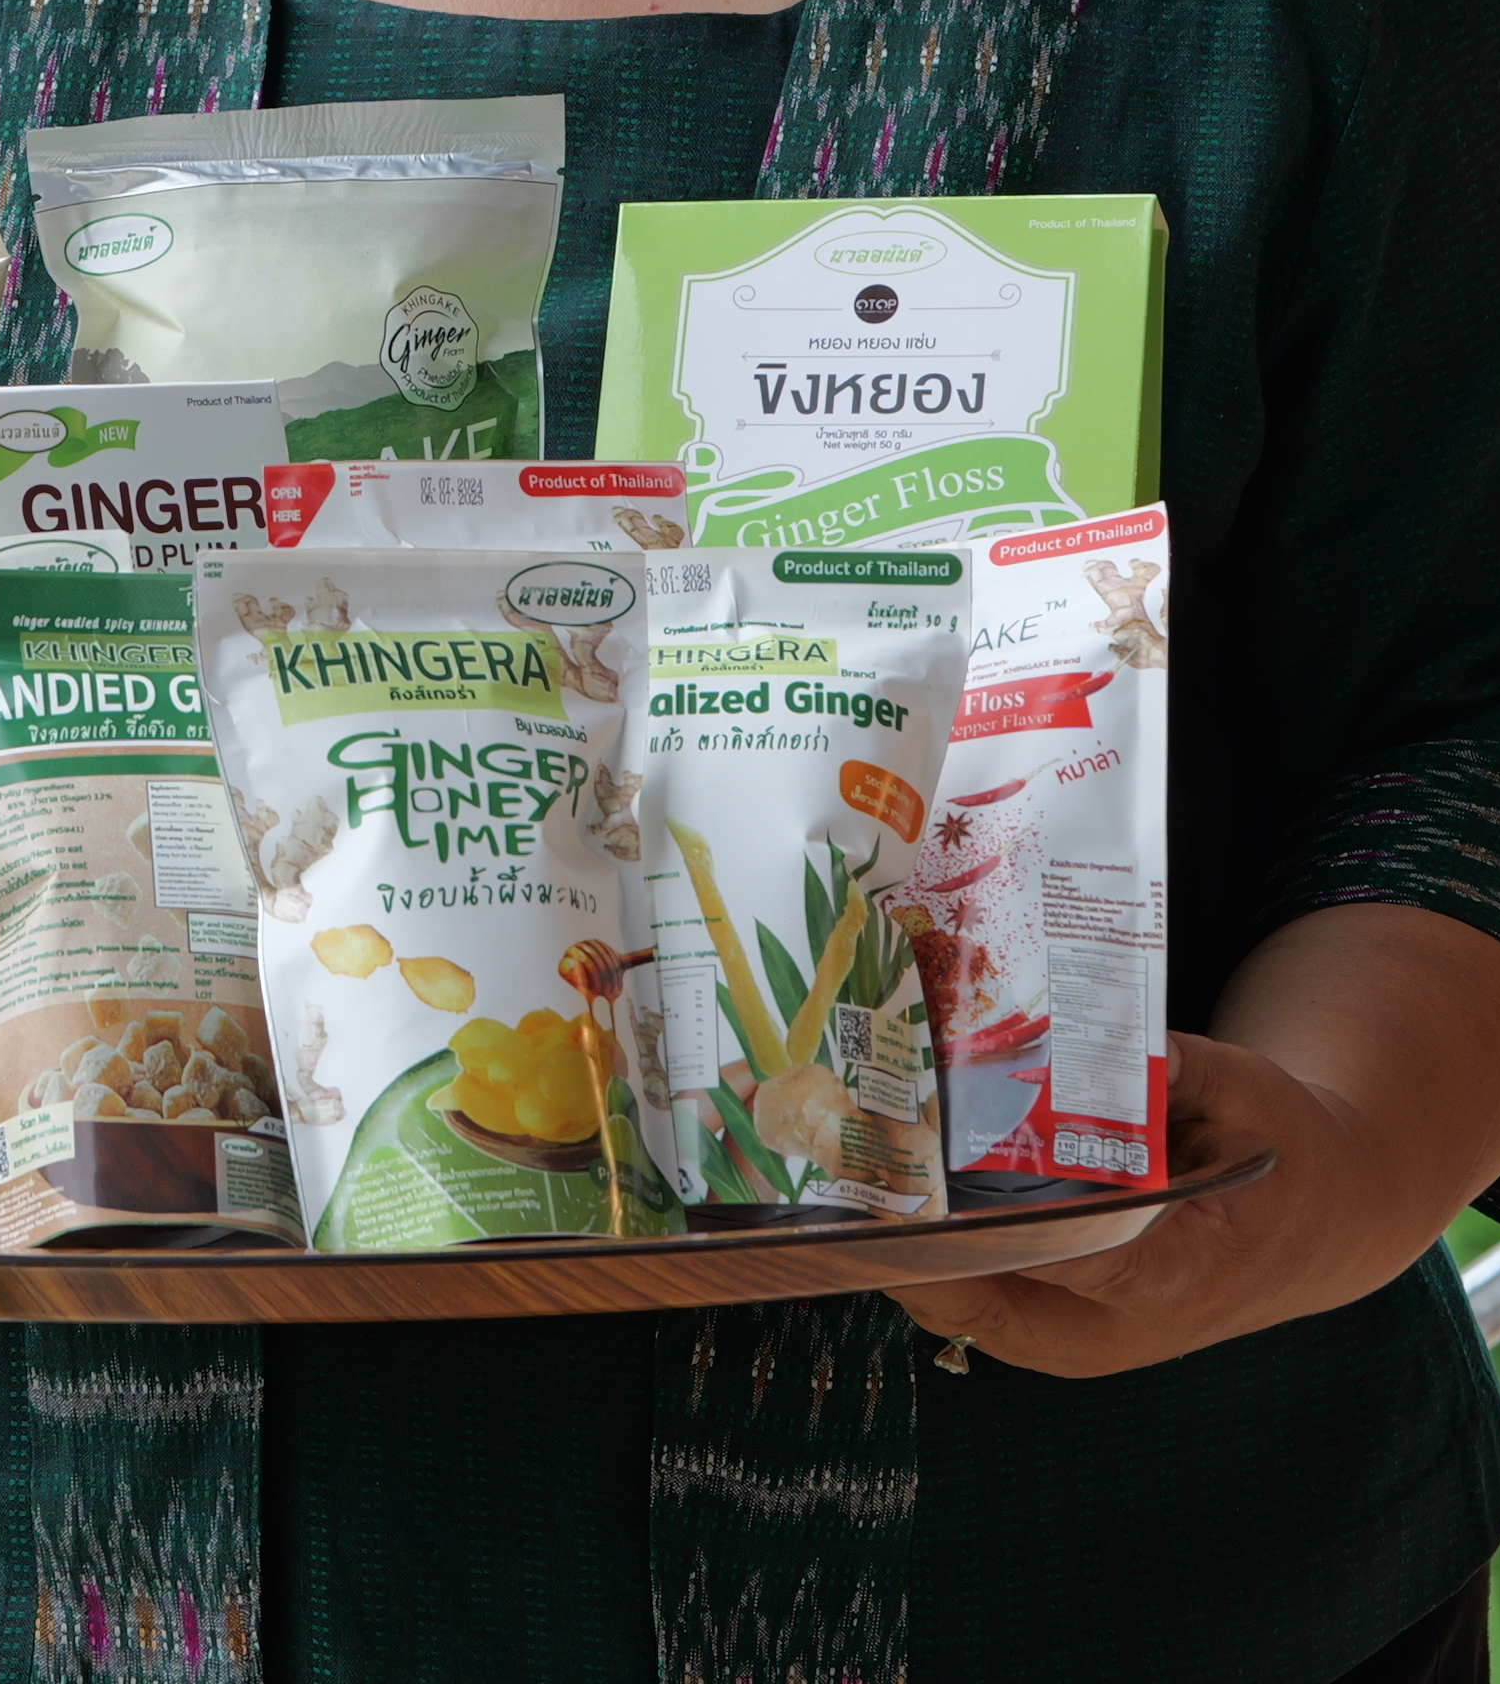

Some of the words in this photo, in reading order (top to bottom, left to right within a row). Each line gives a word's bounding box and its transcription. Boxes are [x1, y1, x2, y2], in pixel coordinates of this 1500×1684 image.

[1029, 219, 1070, 229] Product
[1075, 219, 1086, 228] of
[1091, 217, 1137, 228] Thailand
[401, 294, 461, 318] KHINGAKE
[388, 323, 471, 374] Ginger
[808, 337, 852, 350] หยอง
[857, 337, 900, 350] หยอง
[905, 332, 937, 350] แซ่บ
[443, 347, 465, 357] From
[402, 373, 439, 404] Product
[754, 363, 986, 415] ขิงหยอง
[186, 396, 222, 407] Product
[223, 396, 233, 406] of
[234, 395, 273, 405] Thailand
[98, 425, 130, 444] NEW
[874, 430, 887, 438] 50
[823, 440, 842, 449] Net
[843, 440, 877, 451] weight
[880, 440, 893, 449] 50
[528, 474, 586, 489] Product
[589, 474, 606, 488] of
[608, 474, 673, 489] Thailand
[271, 487, 302, 500] OPEN
[21, 476, 267, 534] GINGER
[736, 493, 881, 547] Ginger
[891, 466, 1005, 511] Floss
[272, 510, 302, 523] HERE
[587, 541, 611, 552] TM
[1000, 538, 1062, 559] Product
[1066, 532, 1083, 547] of
[1086, 518, 1154, 543] Thailand
[784, 559, 854, 577] Product
[855, 561, 875, 576] of
[877, 561, 950, 578] Thailand
[518, 577, 619, 609] นวลอนันต์
[1045, 598, 1067, 612] TM
[12, 614, 50, 631] Ginger
[55, 616, 100, 629] Candied
[104, 618, 135, 633] Spicy
[925, 614, 942, 628] 30
[949, 615, 958, 633] g
[272, 640, 552, 695] KHINGERA
[1053, 656, 1081, 666] Brand
[840, 669, 876, 679] Brand
[389, 685, 477, 701] คิงส์เกอร่า
[784, 681, 909, 732] Ginger
[964, 690, 1026, 716] Floss
[515, 718, 532, 735] By
[951, 720, 998, 739] epper
[1002, 712, 1056, 728] Flavor
[327, 728, 589, 818] GINGER
[8, 801, 26, 811] 85%
[60, 793, 91, 802] (Sugar)
[346, 777, 561, 829] HONEY
[55, 846, 65, 854] to
[59, 862, 69, 870] to
[72, 862, 87, 870] eat
[122, 945, 139, 953] keep
[128, 981, 150, 989] pouch
[196, 991, 212, 999] LOT
